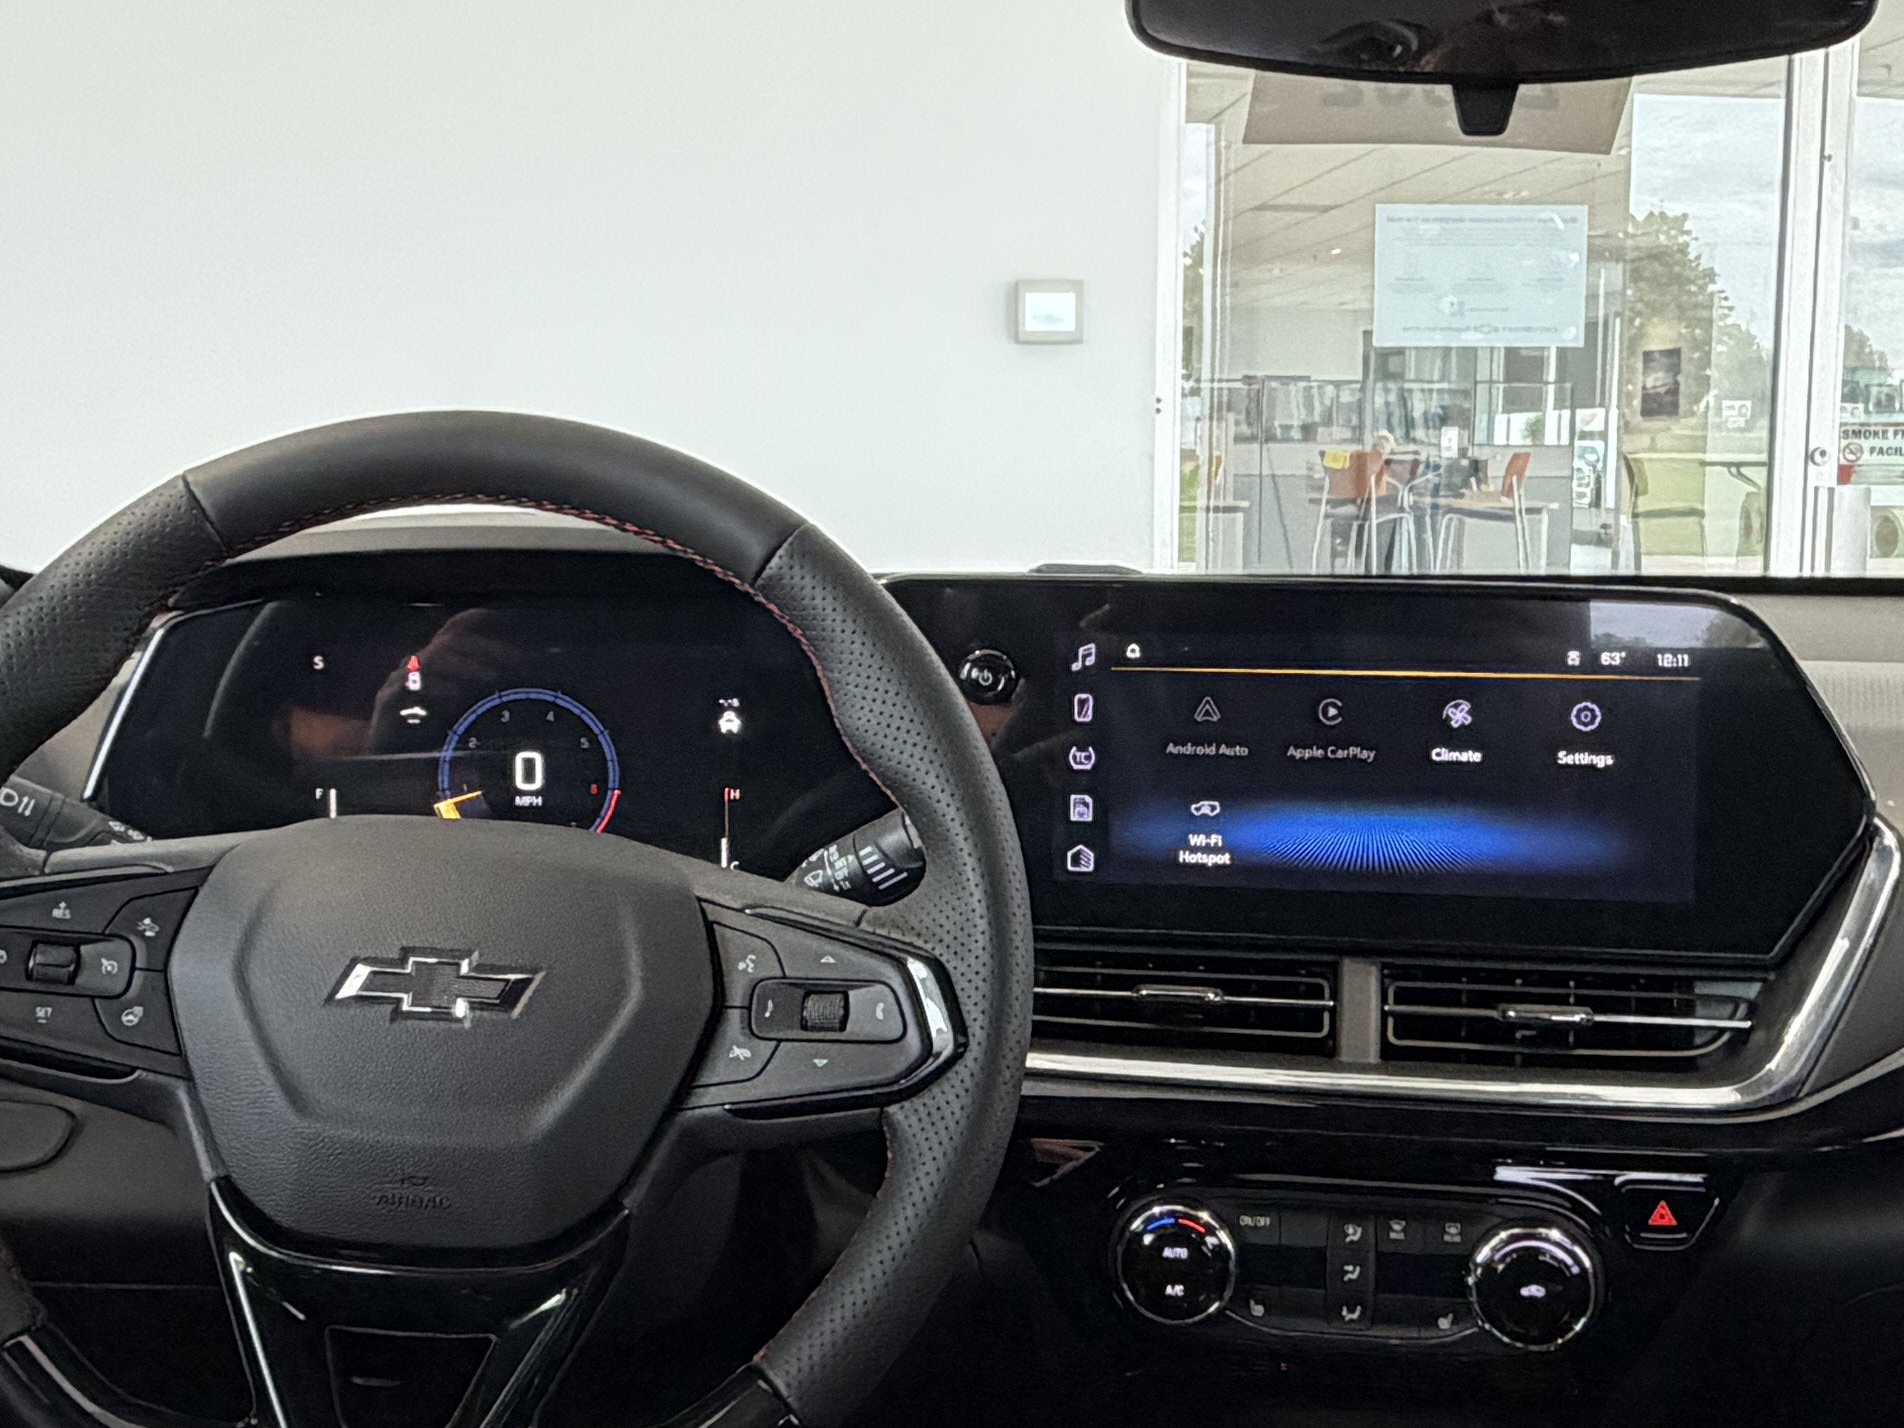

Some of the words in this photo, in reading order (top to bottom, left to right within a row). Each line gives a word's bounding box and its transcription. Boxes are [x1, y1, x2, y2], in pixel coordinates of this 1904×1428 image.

[1841, 428, 1890, 440] SMOKE
[500, 710, 511, 723] 3
[545, 710, 555, 722] 4
[1165, 741, 1216, 756] Android
[1218, 743, 1248, 756] Auto
[1287, 746, 1324, 761] Apple
[1327, 746, 1376, 763] CarPlay
[1430, 747, 1482, 762] Climate
[1556, 750, 1614, 768] Settings
[515, 751, 543, 790] 0
[315, 788, 323, 801] F
[514, 795, 543, 807] MPH
[730, 788, 741, 801] H
[1188, 834, 1223, 847] Wi-Fi
[1179, 850, 1231, 866] Hotspot
[1162, 1246, 1189, 1260] AUTO
[1165, 1284, 1185, 1297] A/C
